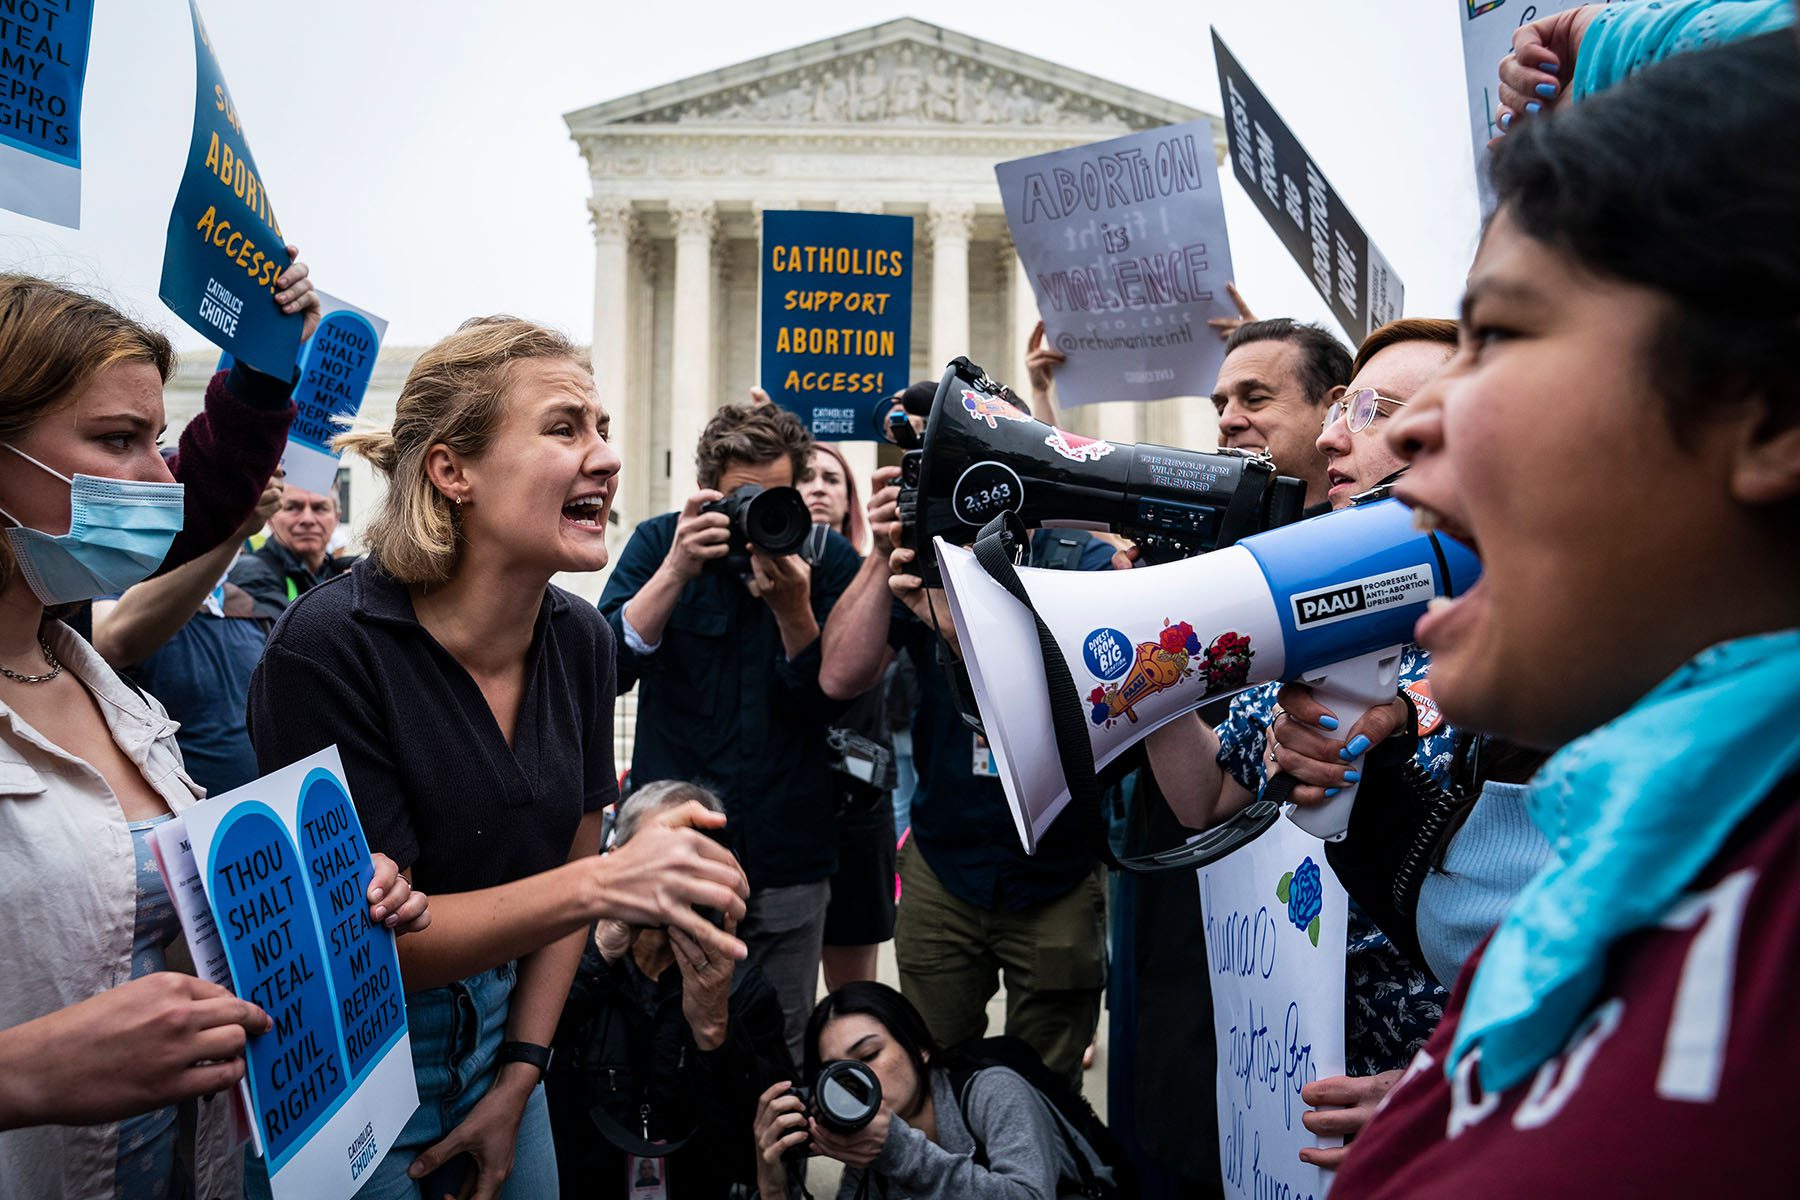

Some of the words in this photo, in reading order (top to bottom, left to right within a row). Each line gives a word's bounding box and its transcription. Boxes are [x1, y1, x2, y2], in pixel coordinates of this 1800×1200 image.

[0, 16, 70, 67] TEAL
[2, 47, 45, 80] MY
[0, 73, 66, 117] EPRO
[1227, 75, 1256, 183] DIVEST
[1254, 120, 1280, 211] FROM
[1283, 174, 1304, 231] BIG
[197, 205, 281, 294] ACCESS!
[1101, 223, 1130, 254] is
[1306, 161, 1332, 305] ABORTION
[772, 246, 903, 277] CATHOLICS
[1037, 243, 1213, 312] VIOLENCE
[1335, 229, 1357, 320] NOW!
[207, 277, 244, 315] CATHOLICS
[784, 290, 891, 315] SUPPORT
[199, 297, 239, 339] CHOICE
[327, 323, 369, 351] THOU
[317, 338, 366, 368] SHALT
[776, 327, 896, 357] ABORTION
[1056, 324, 1193, 354] @rehumanizeintl
[308, 370, 353, 399] STEAL
[321, 356, 353, 380] NOT
[784, 370, 883, 393] ACCESS!
[313, 391, 338, 409] MY
[813, 408, 854, 418] CATHOLICS
[812, 422, 854, 434] CHOICE
[1141, 455, 1161, 464] THE
[1150, 465, 1175, 475] WILL
[1176, 468, 1200, 478] NOT
[1200, 472, 1217, 482] BE
[964, 483, 1011, 510] 2,363
[1153, 475, 1210, 491] TELEVISED
[1364, 572, 1418, 592] PROGRESSIVE
[1366, 578, 1430, 600] ANTI-ABORTION
[1366, 594, 1404, 608] UPRISING
[1302, 590, 1359, 619] PAAU
[1088, 629, 1109, 651] DIVEST
[1093, 636, 1116, 660] FROM
[1100, 644, 1122, 672] BIG
[1123, 675, 1147, 702] PAAU
[303, 803, 349, 849] THOU
[219, 840, 283, 897] THOU
[312, 835, 362, 888] SHALT
[228, 875, 294, 941] SHALT
[329, 871, 363, 916] NOT
[330, 908, 372, 957] STEA
[1205, 873, 1276, 979] human
[251, 919, 293, 974] NOT
[350, 940, 371, 981] MY
[343, 963, 390, 1027] REPRO
[275, 997, 303, 1047] MY
[346, 992, 399, 1065] RIGHTS
[271, 1030, 323, 1091] CIVIL
[1229, 997, 1281, 1110] rights
[1284, 1001, 1317, 1131] for
[265, 1053, 338, 1143] RIGHTS
[347, 1121, 374, 1160] CATHOLICS
[351, 1138, 377, 1181] CHOICE
[1225, 1102, 1246, 1195] all
